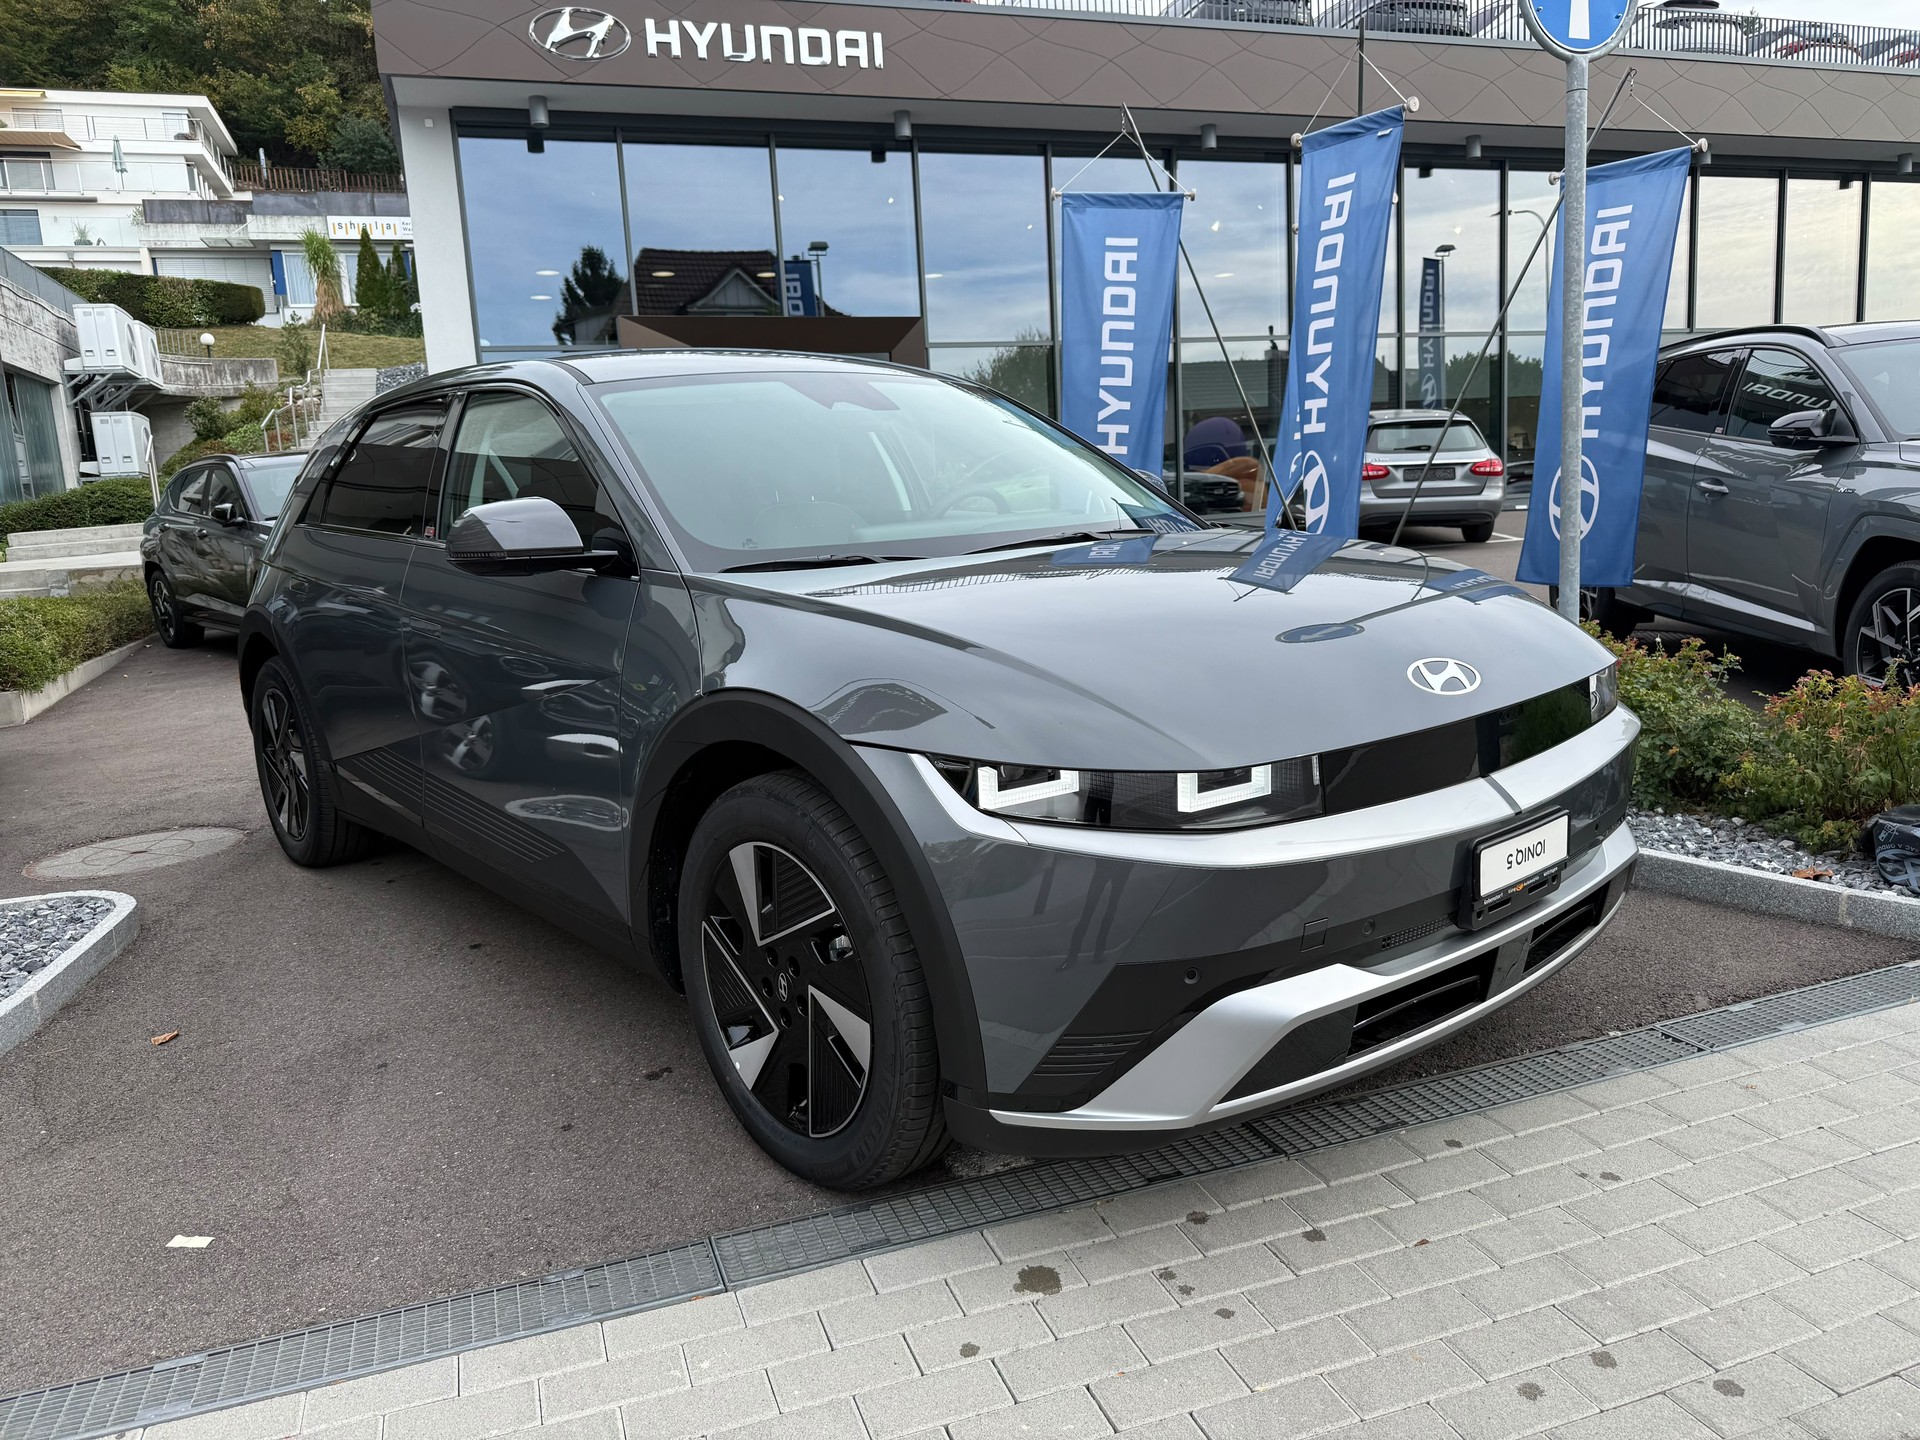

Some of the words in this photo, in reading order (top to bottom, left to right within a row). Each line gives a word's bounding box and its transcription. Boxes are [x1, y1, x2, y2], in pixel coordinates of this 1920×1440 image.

[645, 18, 884, 69] HYUNDAI
[1096, 237, 1138, 455] HYUNDAI
[1507, 853, 1513, 870] 5
[1516, 839, 1546, 865] IONIQ
